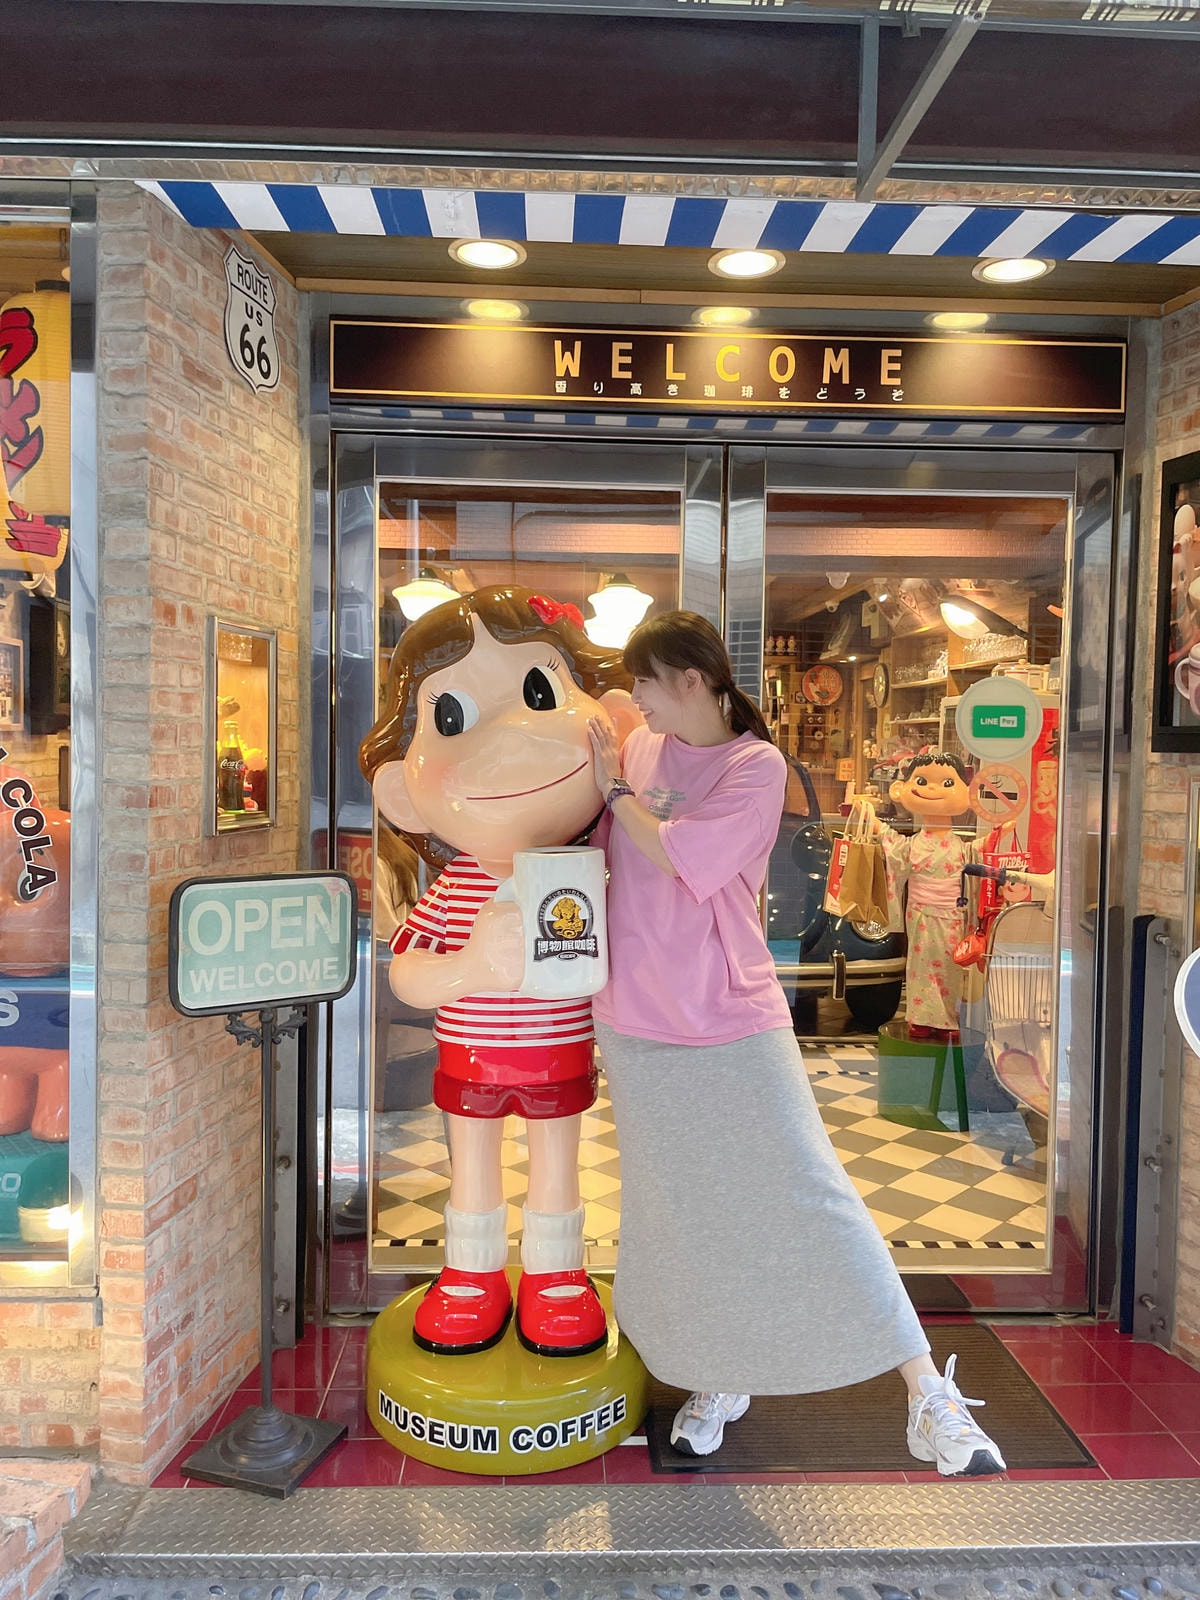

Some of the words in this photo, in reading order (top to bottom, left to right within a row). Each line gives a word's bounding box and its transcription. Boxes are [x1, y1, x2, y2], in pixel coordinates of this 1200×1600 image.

[236, 263, 268, 304] ROUTE
[245, 302, 262, 327] US
[240, 323, 271, 379] 66
[554, 339, 902, 386] WELCOME
[980, 717, 999, 725] LINE
[1002, 718, 1015, 727] Pay
[1, 778, 58, 894] COLA
[998, 856, 1029, 872] Milky
[187, 894, 341, 956] OPEN
[189, 956, 339, 994] WELCOME
[379, 1389, 500, 1454] MUSEUM
[510, 1394, 627, 1454] COFFEE
